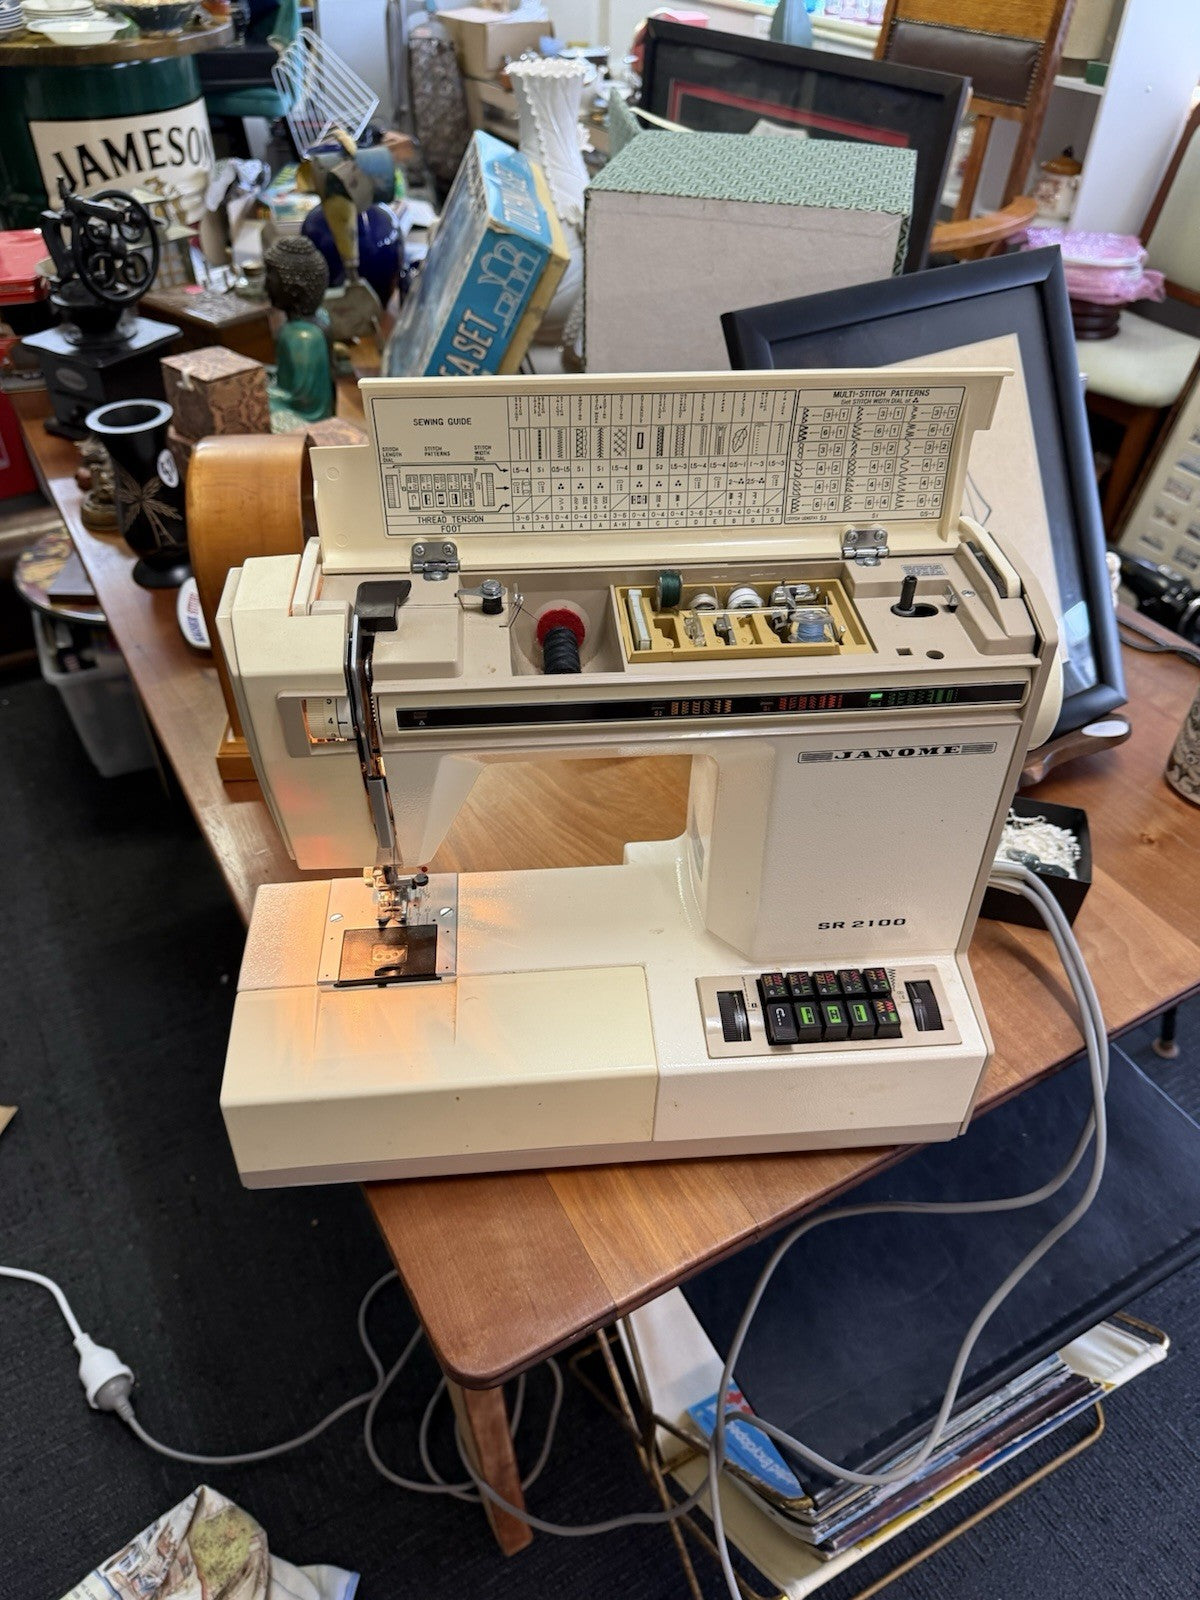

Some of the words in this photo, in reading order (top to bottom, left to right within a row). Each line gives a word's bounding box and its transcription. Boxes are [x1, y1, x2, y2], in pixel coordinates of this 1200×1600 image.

[52, 127, 214, 193] JAMESON
[451, 308, 499, 359] SET
[833, 390, 886, 398] MULTI-STITCH
[890, 389, 930, 397] PATTERNS
[413, 418, 444, 426] SEWING
[448, 418, 472, 426] GUIDE
[834, 745, 961, 760] JANOME
[818, 922, 845, 930] SR
[852, 918, 906, 928] 2100
